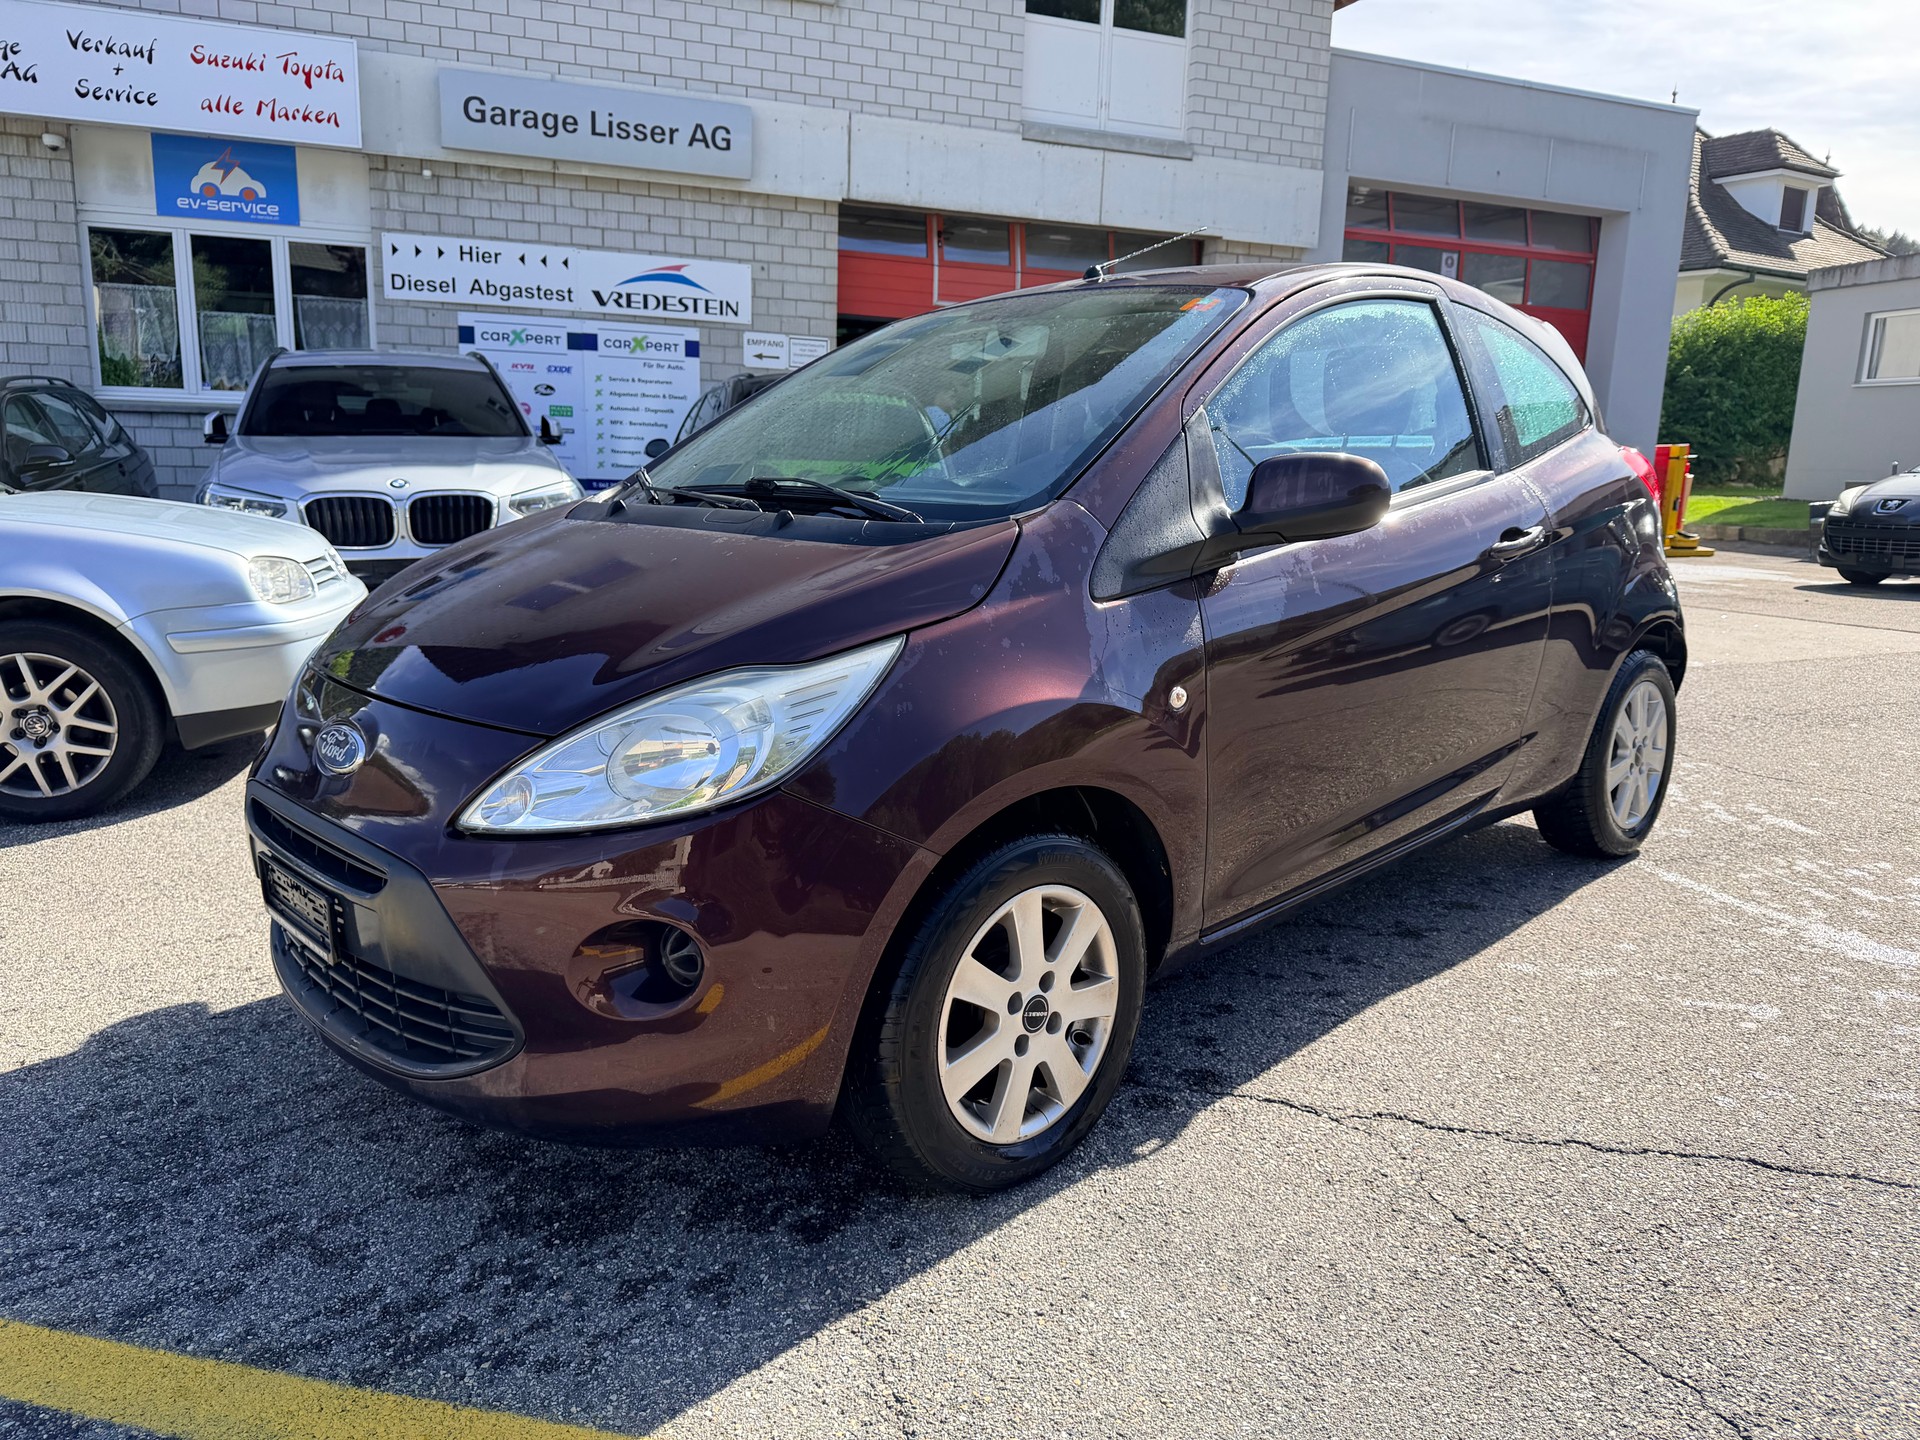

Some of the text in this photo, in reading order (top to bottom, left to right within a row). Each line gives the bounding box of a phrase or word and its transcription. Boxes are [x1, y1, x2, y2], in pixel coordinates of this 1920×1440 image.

[65, 29, 157, 64] Verkauf
[0, 61, 38, 83] AG
[190, 44, 345, 89] Suzuki Toyota
[75, 78, 159, 106] Service
[200, 94, 340, 128] alle Marken
[463, 95, 732, 151] Garage Lisser AG
[176, 197, 280, 216] ev-service
[459, 245, 502, 264] Hier
[391, 273, 574, 302] Diesel Abgastest
[591, 290, 739, 317] VREDESTEIN
[747, 338, 784, 348] EMPFANG
[546, 365, 573, 374] EXIDE
[321, 731, 350, 762] Ford
